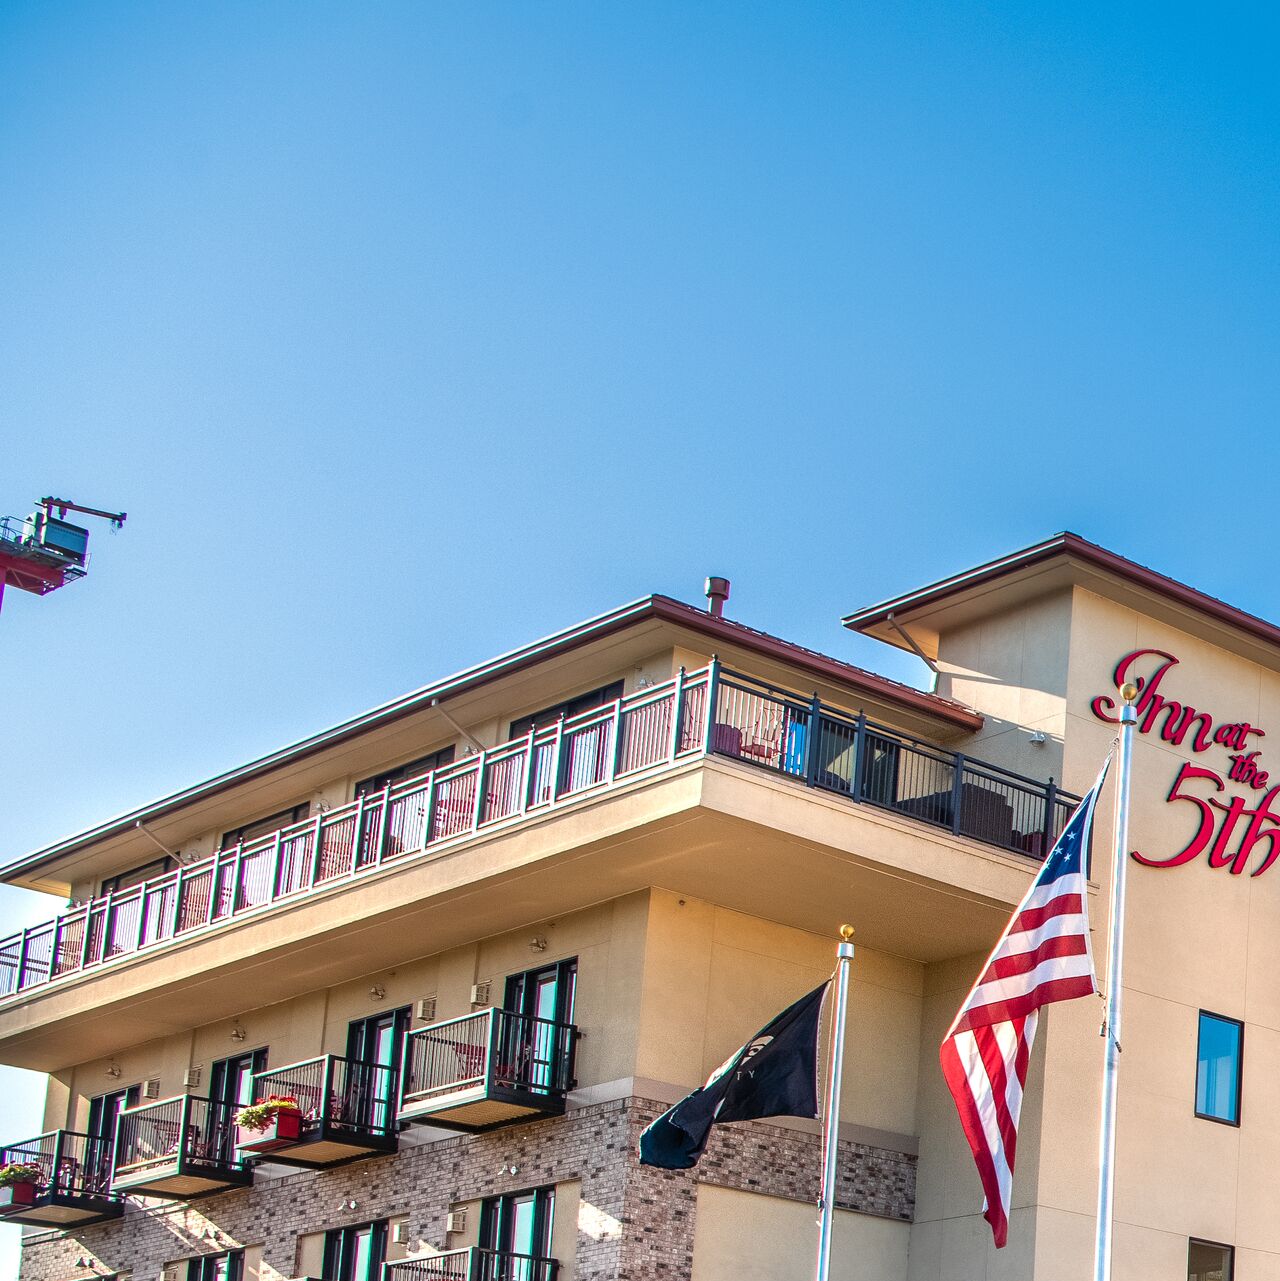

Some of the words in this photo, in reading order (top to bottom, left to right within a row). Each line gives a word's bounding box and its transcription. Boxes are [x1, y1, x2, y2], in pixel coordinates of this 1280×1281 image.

[1091, 649, 1212, 752] Inn
[1213, 722, 1265, 751] at
[1228, 751, 1269, 789] the
